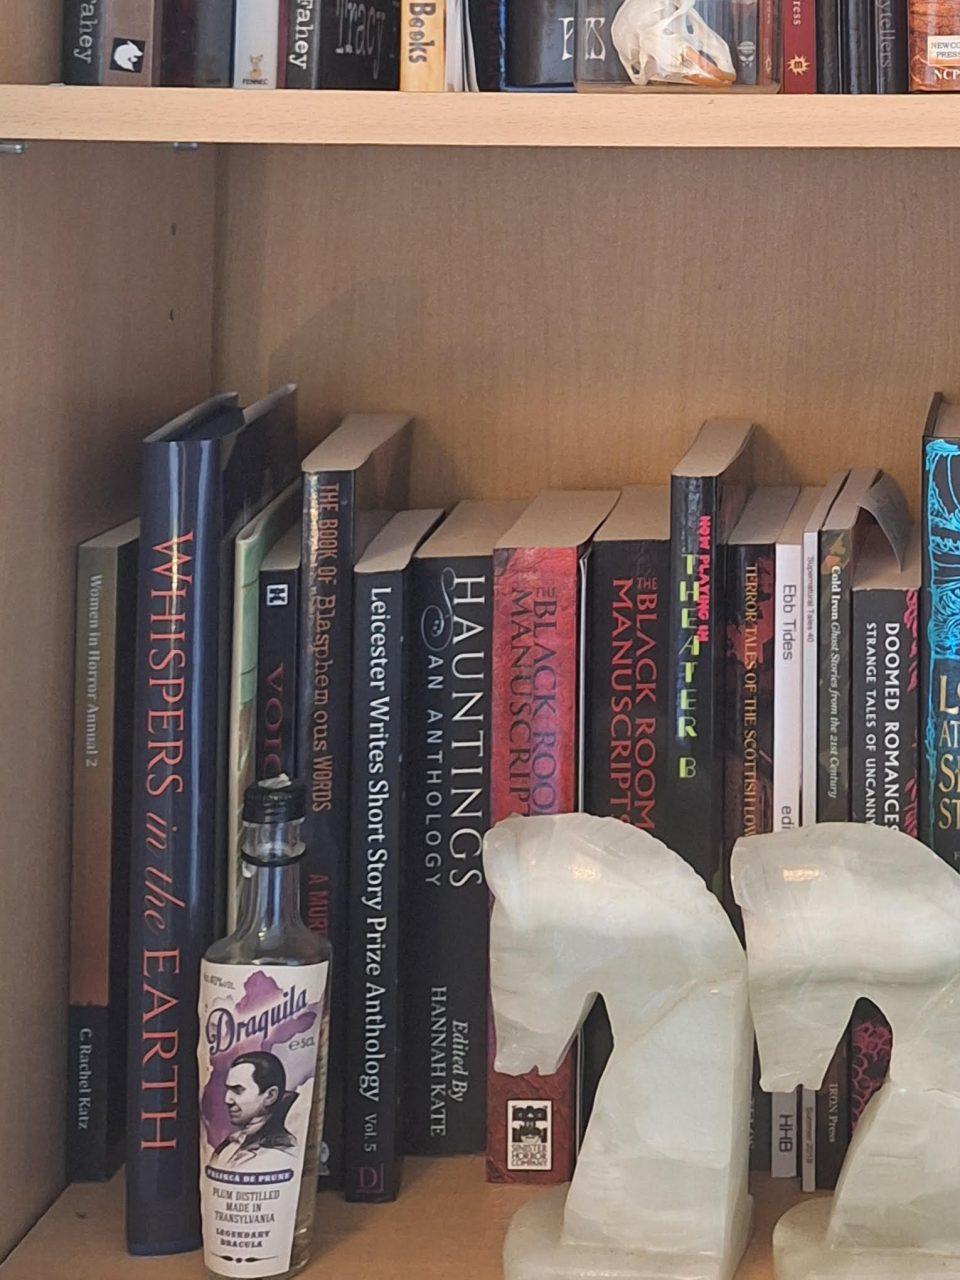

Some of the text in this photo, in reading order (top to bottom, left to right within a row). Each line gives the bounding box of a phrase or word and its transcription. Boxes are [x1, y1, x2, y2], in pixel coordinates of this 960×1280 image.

[311, 518, 340, 812] BOOK Blasphemous WORDS
[449, 574, 486, 889] HAUNTINGS
[532, 600, 558, 715] BLACK
[634, 592, 658, 703] BLACK
[744, 563, 758, 803] TERROR TALES SCOTTISH
[864, 622, 877, 728] STRANGE TALES
[883, 622, 901, 832] DOOMED ROMANCES
[77, 573, 103, 1130] Women Horror Annual Rachel Katz
[140, 529, 194, 1152] WHISPERS the EARTH
[359, 586, 391, 1102] Leicester Writes Short Story Prize Anthology
[425, 654, 445, 888] AN ANTHOLOGY
[778, 619, 797, 1152] Tides HHB
[205, 985, 308, 1056] Draquila
[430, 985, 448, 1138] HANNAH KATE
[451, 1019, 470, 1076] Edited
[214, 1210, 276, 1225] TRANSYLVANIA
[215, 1228, 271, 1239] LEGENDARY
[235, 1189, 281, 1202] DISTILLED
